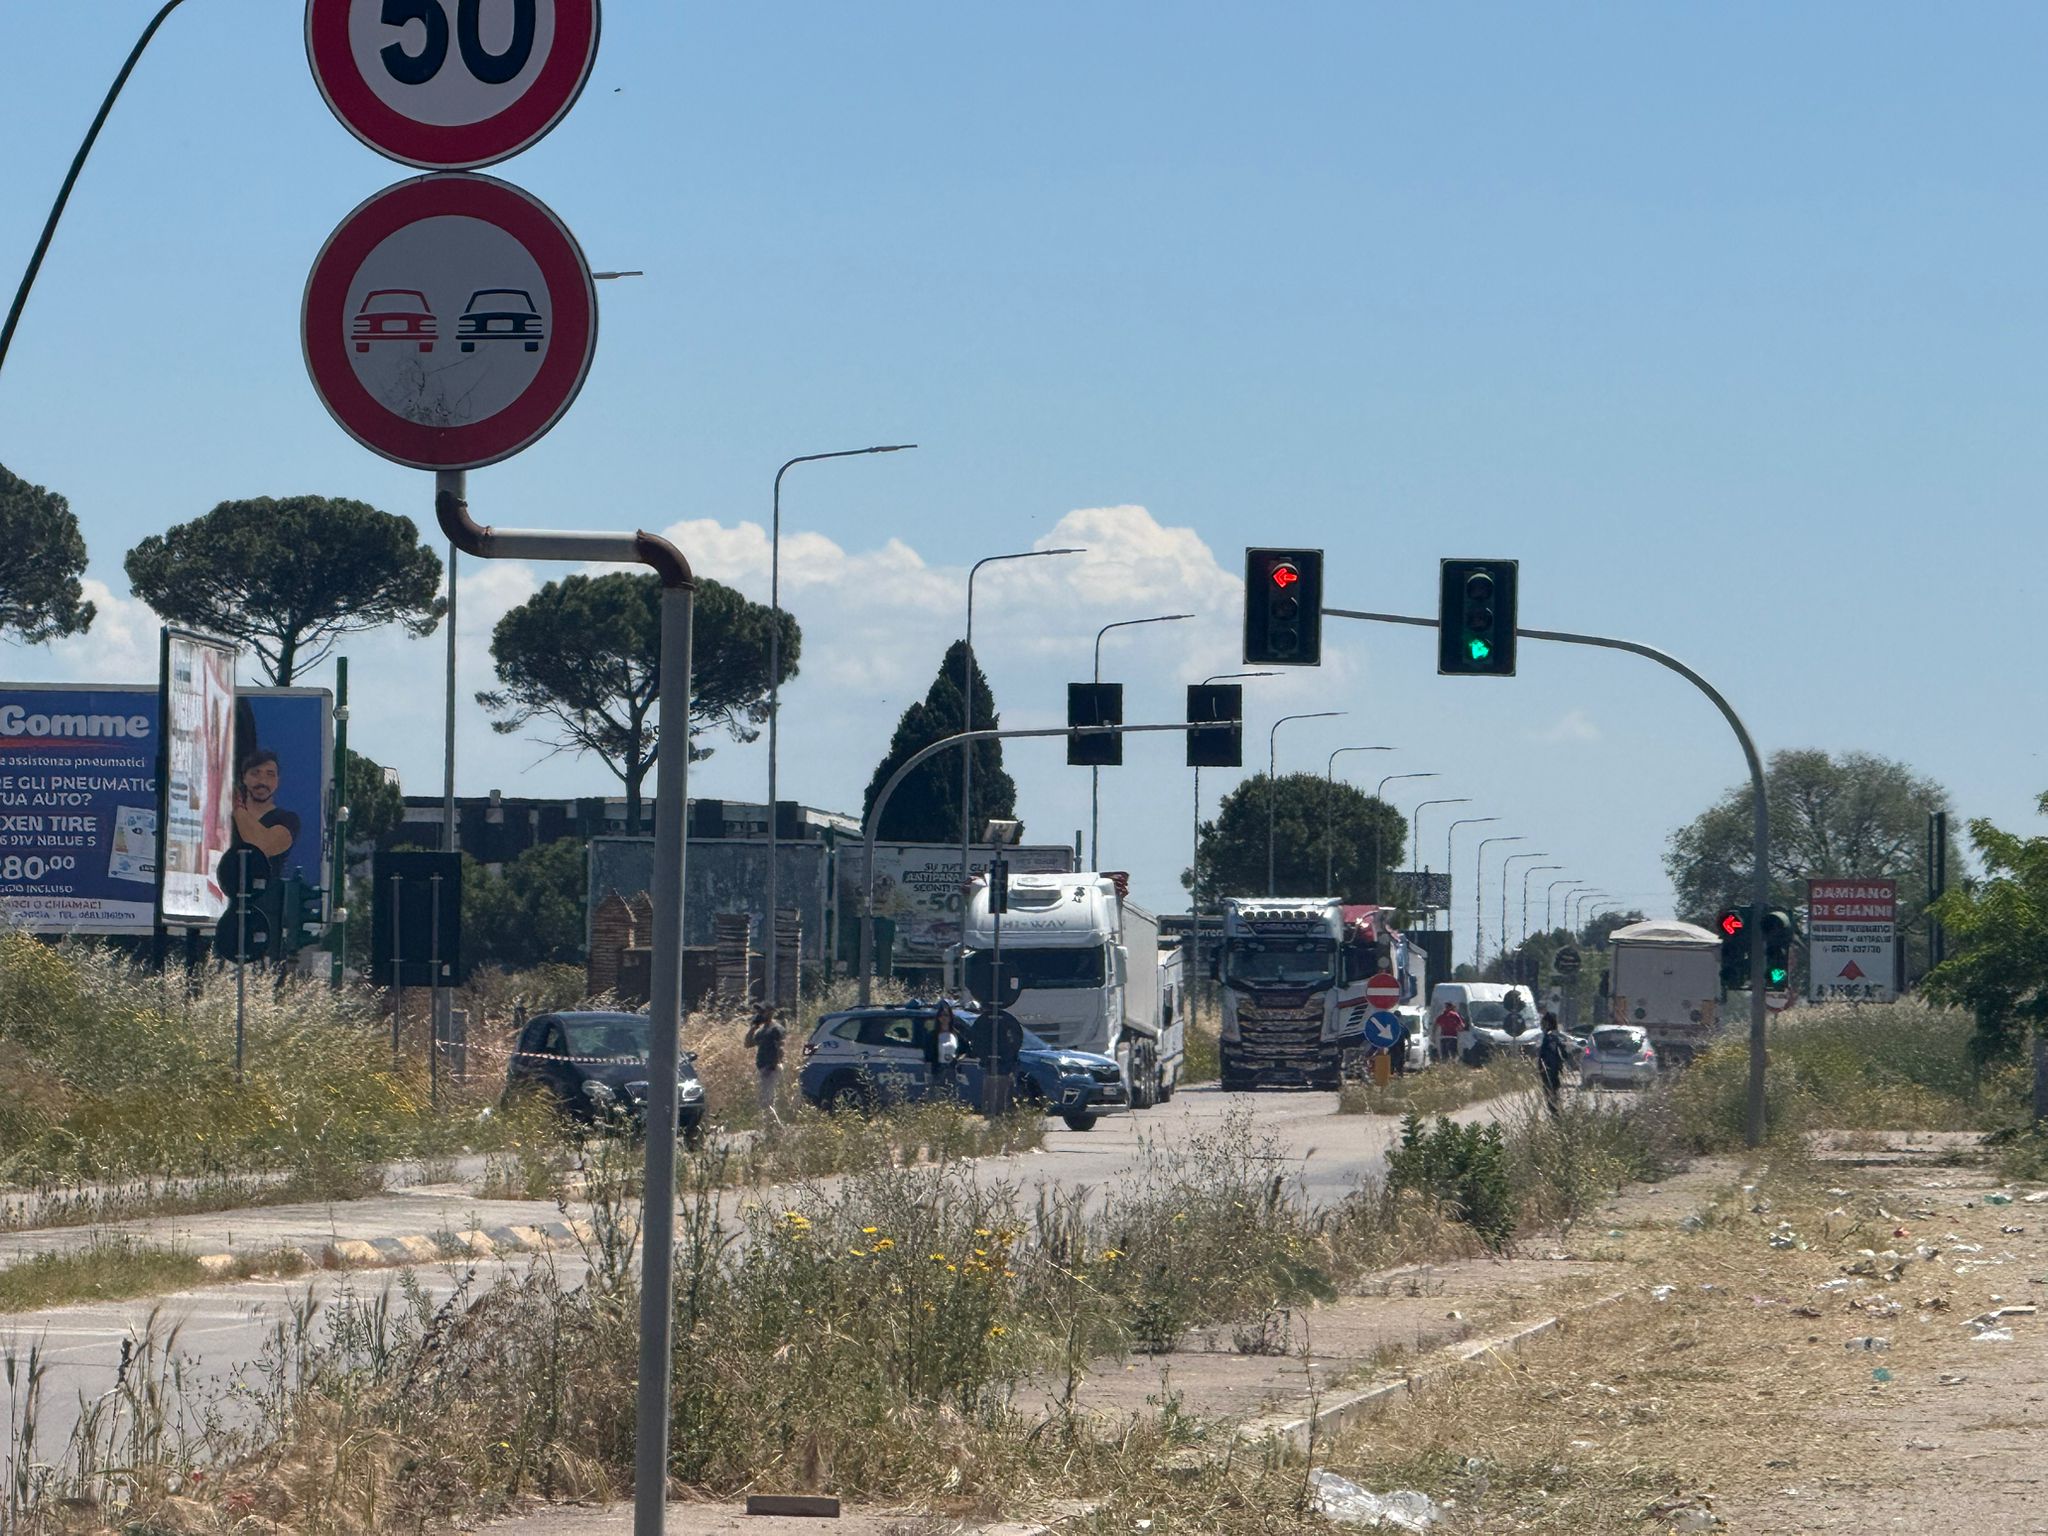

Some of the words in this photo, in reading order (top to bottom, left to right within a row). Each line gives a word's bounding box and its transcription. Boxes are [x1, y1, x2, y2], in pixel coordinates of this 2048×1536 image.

[379, 0, 536, 85] 50
[0, 705, 150, 737] Gomme
[9, 755, 72, 766] assistenza
[74, 757, 146, 769] pneumatici
[18, 777, 46, 790] GLI
[32, 793, 93, 806] AUTO?
[0, 815, 43, 832] XEN
[48, 815, 97, 832] TIRE
[37, 835, 84, 846] NBLUE
[87, 836, 97, 847] S
[26, 885, 74, 893] INCLUSO
[1812, 887, 1893, 899] DAMIANO
[44, 900, 102, 910] CHIAMACI
[1812, 904, 1829, 916] DI
[1833, 904, 1893, 917] GIANNI
[1002, 920, 1066, 928] HI-WAY
